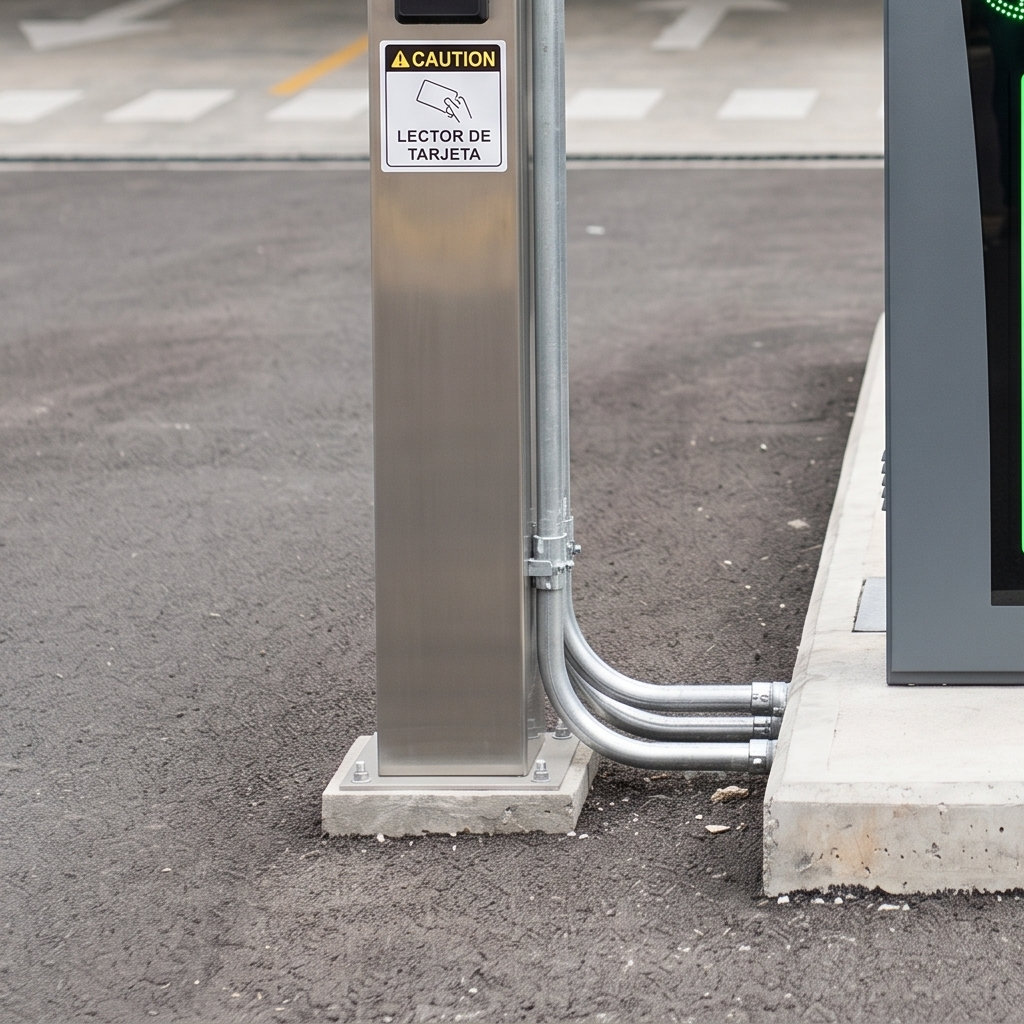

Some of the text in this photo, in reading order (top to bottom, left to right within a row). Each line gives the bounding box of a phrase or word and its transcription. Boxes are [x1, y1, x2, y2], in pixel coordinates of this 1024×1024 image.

[412, 51, 496, 67] CAUTION
[397, 129, 491, 143] LECTOR DE
[407, 147, 481, 161] TARJETA
